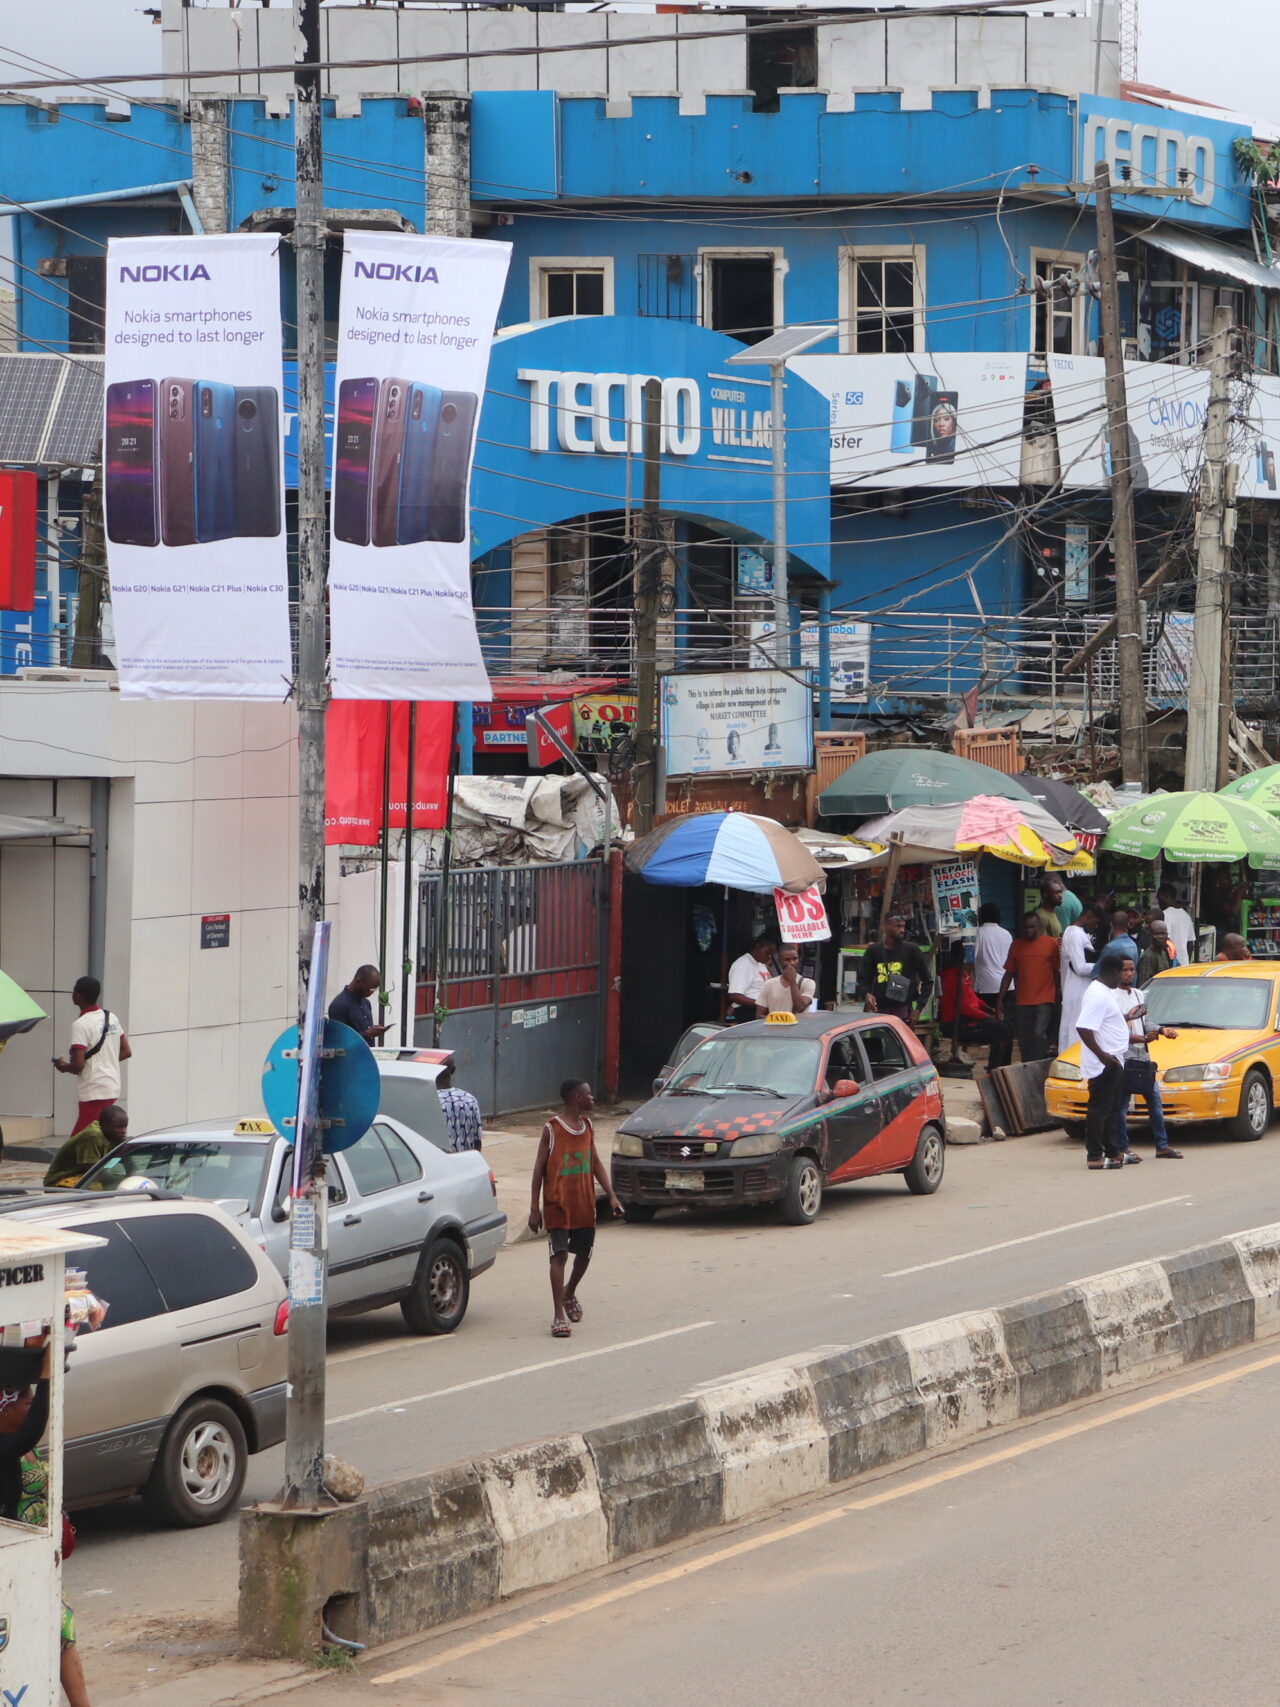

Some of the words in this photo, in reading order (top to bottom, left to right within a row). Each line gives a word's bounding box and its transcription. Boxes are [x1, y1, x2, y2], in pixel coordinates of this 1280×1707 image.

[120, 264, 211, 283] NOKIA
[354, 261, 439, 284] NOKIA
[124, 310, 161, 323] Nokia
[164, 308, 252, 325] smartphones
[356, 306, 389, 321] Nokia
[392, 311, 470, 328] smartphones
[114, 329, 174, 347] designed
[178, 331, 192, 343] to
[196, 329, 220, 342] last
[223, 328, 265, 345] longer
[347, 326, 400, 345] designed
[403, 331, 414, 344] to
[417, 331, 437, 345] last
[440, 331, 479, 350] longer
[711, 387, 745, 404] COMPUTER
[846, 392, 863, 405] 5G
[830, 393, 840, 425] Series
[711, 407, 786, 451] VILLAG
[112, 585, 132, 593] Nokia
[133, 585, 148, 593] G20
[150, 585, 171, 593] Nokia
[189, 585, 209, 593] Nokia
[226, 584, 242, 592] Plus
[246, 584, 267, 592] Nokia
[333, 583, 347, 592] Nokia
[361, 585, 377, 593] Nokia
[391, 587, 407, 595] Nokia
[420, 588, 432, 597] Plus
[831, 624, 856, 635] lobal
[688, 689, 697, 698] This
[698, 689, 702, 697] is
[731, 687, 743, 697] public
[745, 687, 754, 695] that
[696, 700, 709, 711] village
[715, 700, 726, 708] under
[738, 698, 767, 708] management
[710, 711, 731, 720] MARKET
[732, 710, 767, 719] COMMITTEE
[484, 731, 528, 743] PARTNE
[937, 876, 974, 889] FLASH
[774, 886, 825, 923] POS
[787, 921, 827, 933] AVAILABLE
[791, 931, 814, 940] HERE
[769, 1014, 790, 1022] TAXI
